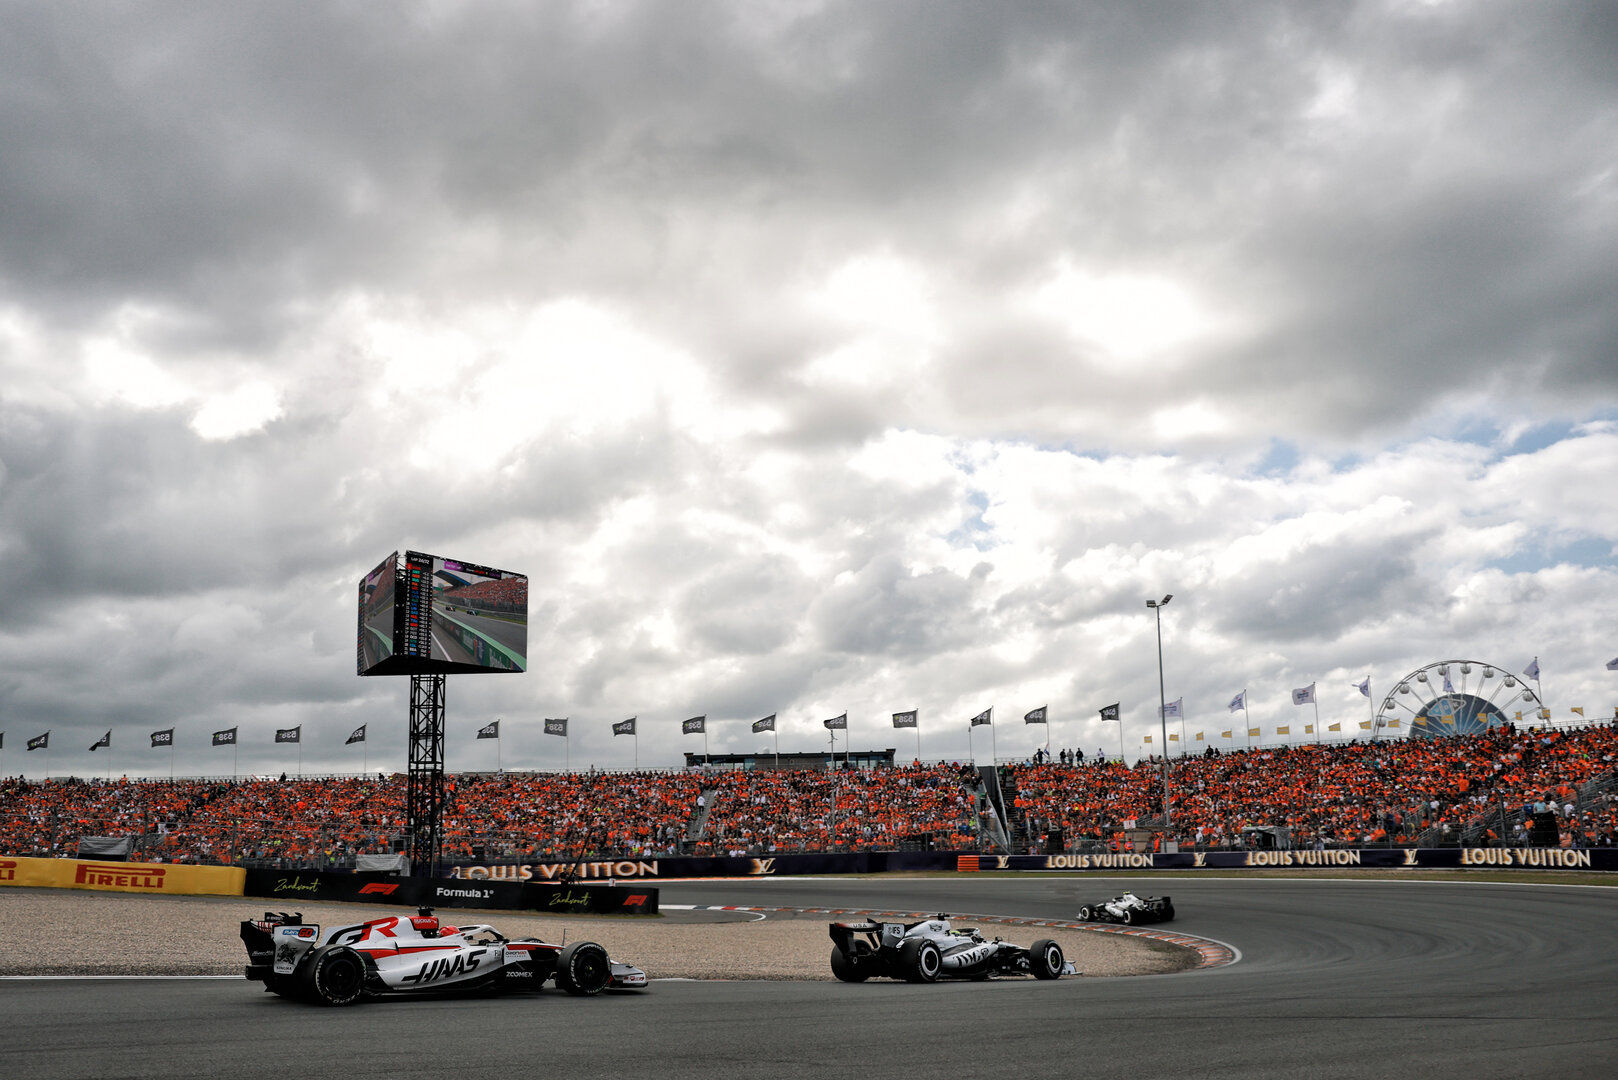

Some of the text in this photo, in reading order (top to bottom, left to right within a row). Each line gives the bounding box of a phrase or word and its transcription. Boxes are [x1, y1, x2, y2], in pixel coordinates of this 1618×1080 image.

[1047, 853, 1154, 868] LOUIS VUITTON
[1247, 849, 1361, 866] LOUIS VUITTON
[1462, 848, 1591, 867] LOUIS VUITTON
[75, 863, 166, 889] PIRELLI
[436, 887, 482, 898] Formula
[299, 928, 314, 937] GO
